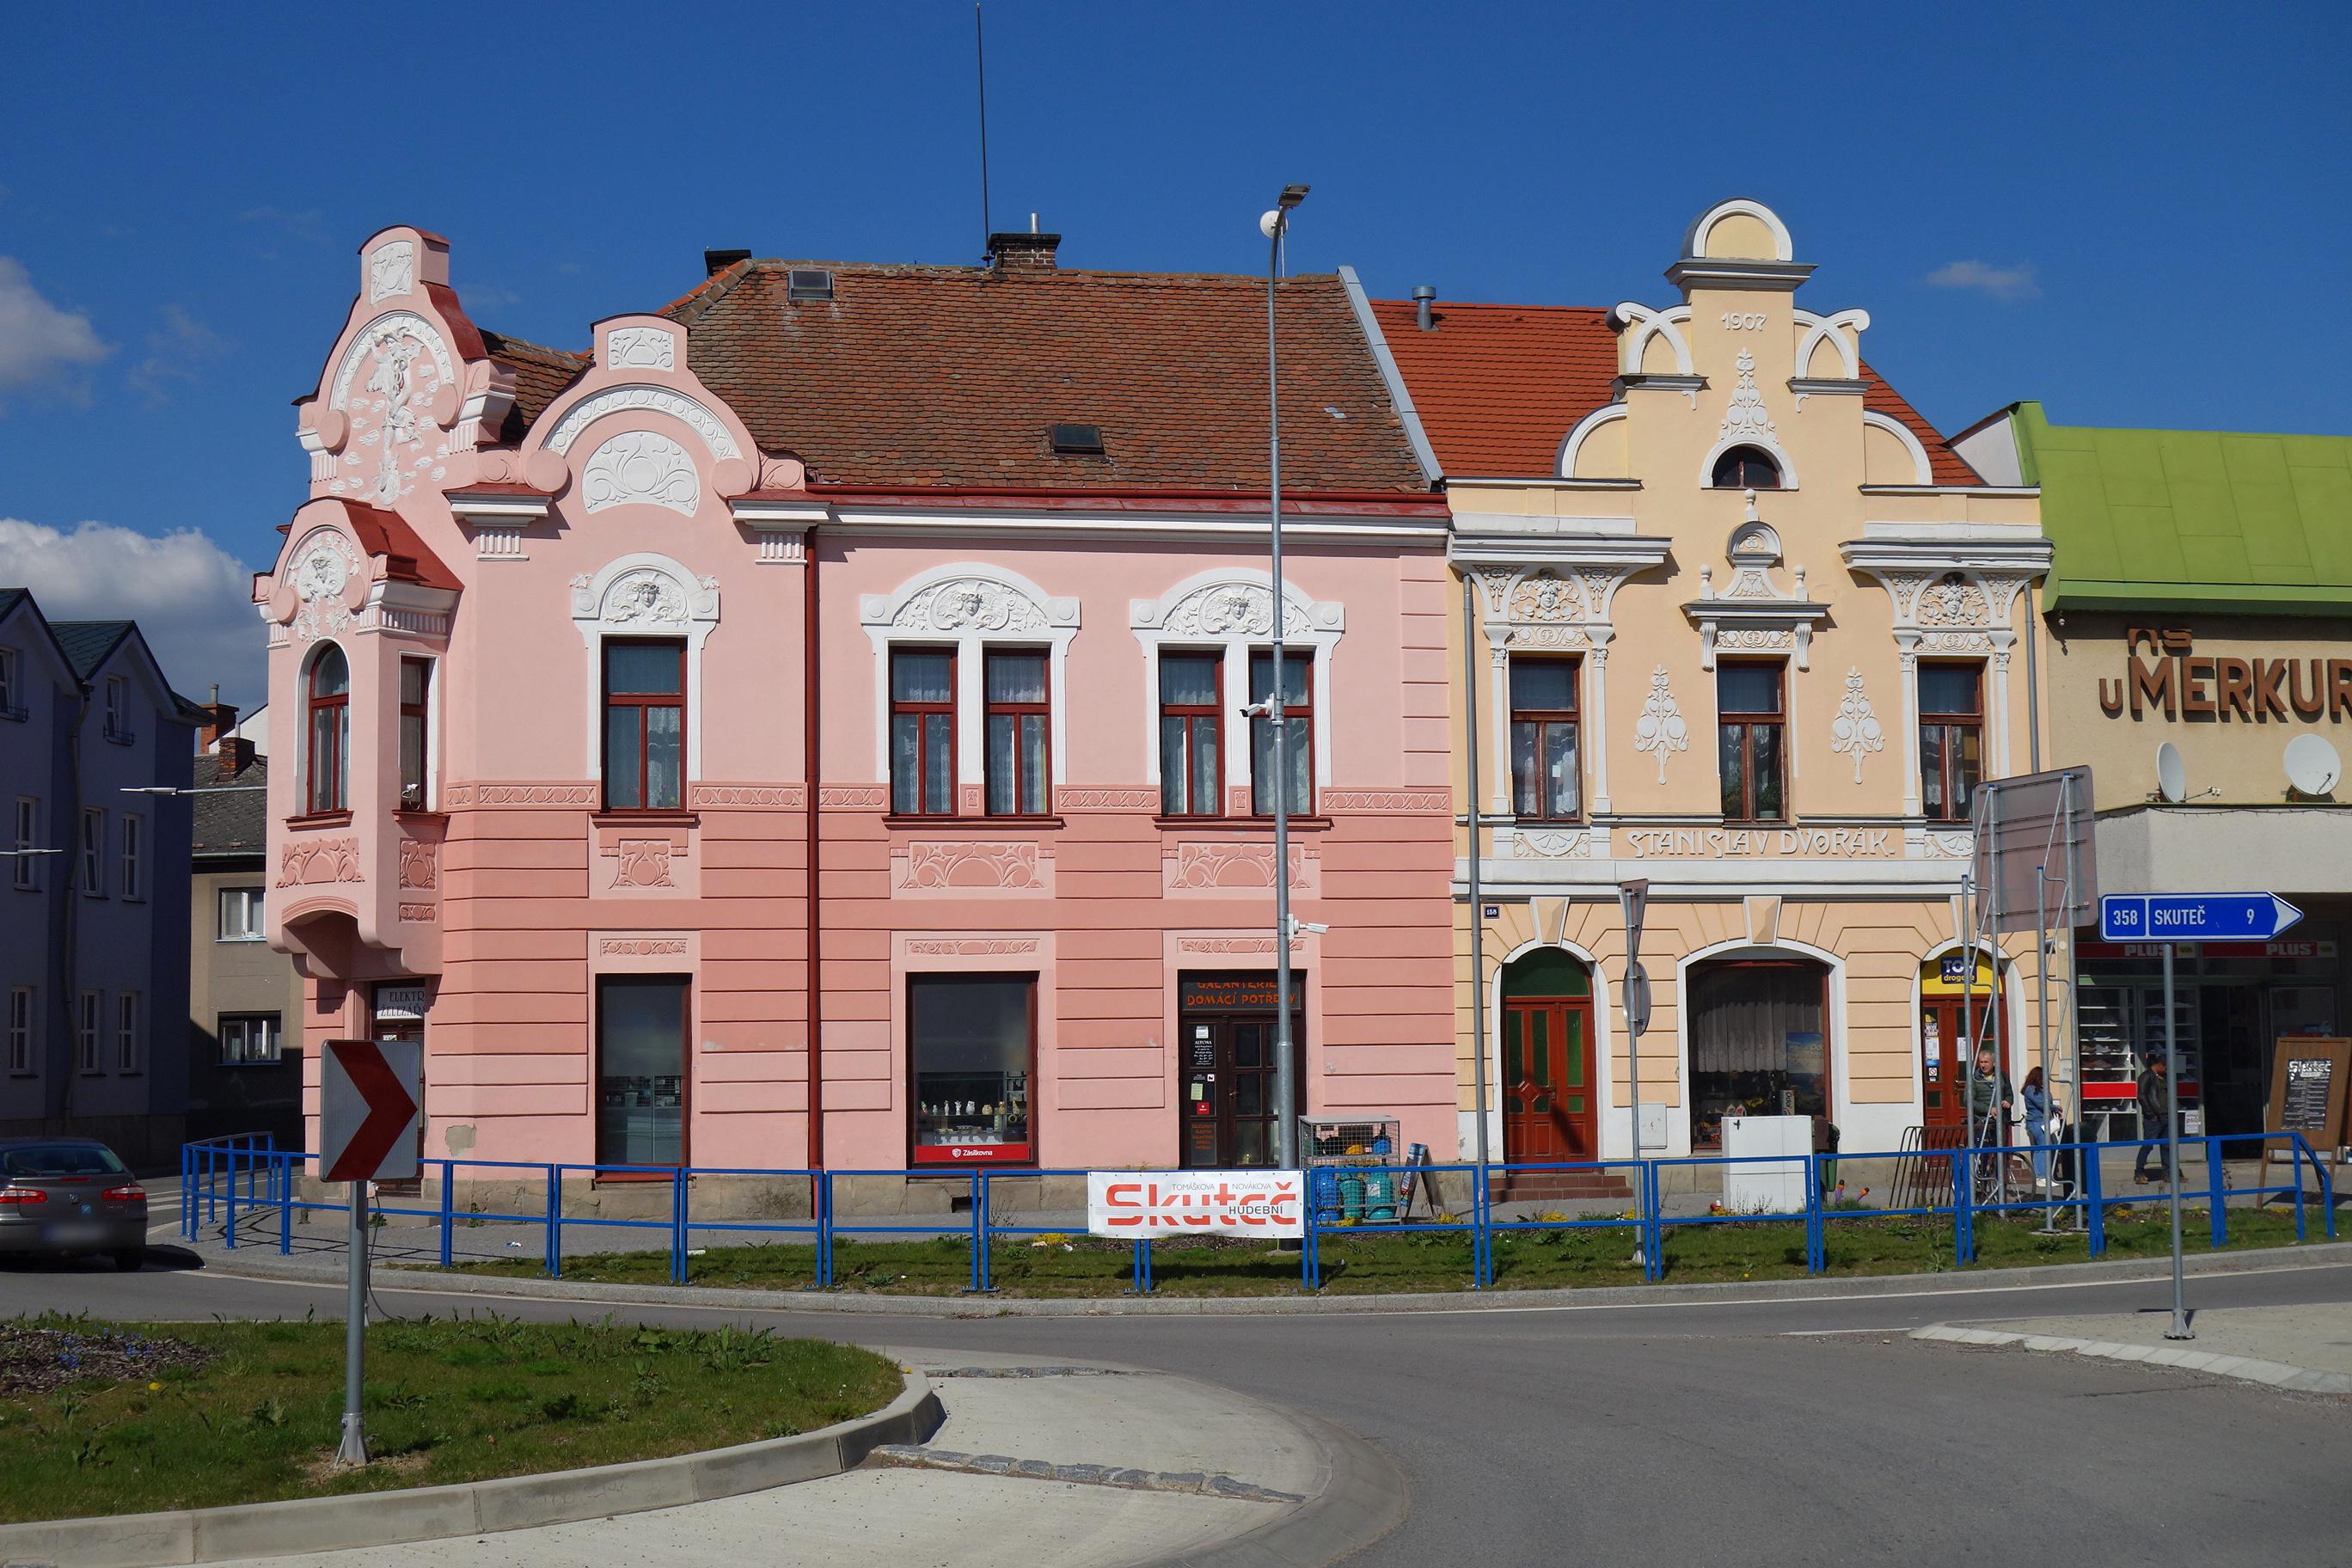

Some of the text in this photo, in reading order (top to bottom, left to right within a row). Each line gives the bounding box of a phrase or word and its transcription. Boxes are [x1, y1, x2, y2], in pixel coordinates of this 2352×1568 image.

[1721, 312, 1767, 331] 1907
[2128, 656, 2352, 713] MERKUR
[1626, 829, 1769, 858] STANISLAV
[2113, 905, 2256, 926] 358 SKUTEČ 9
[2266, 942, 2312, 956] PLUS
[1943, 959, 1975, 973] TO
[389, 991, 425, 1002] ELEKTR
[1186, 990, 1296, 1007] DOMÁCÍ POTŘEY
[1232, 1182, 1271, 1191] NOVÁKOVA
[1106, 1181, 1296, 1226] Skuteč
[1228, 1204, 1283, 1215] HUDEBNÍ
